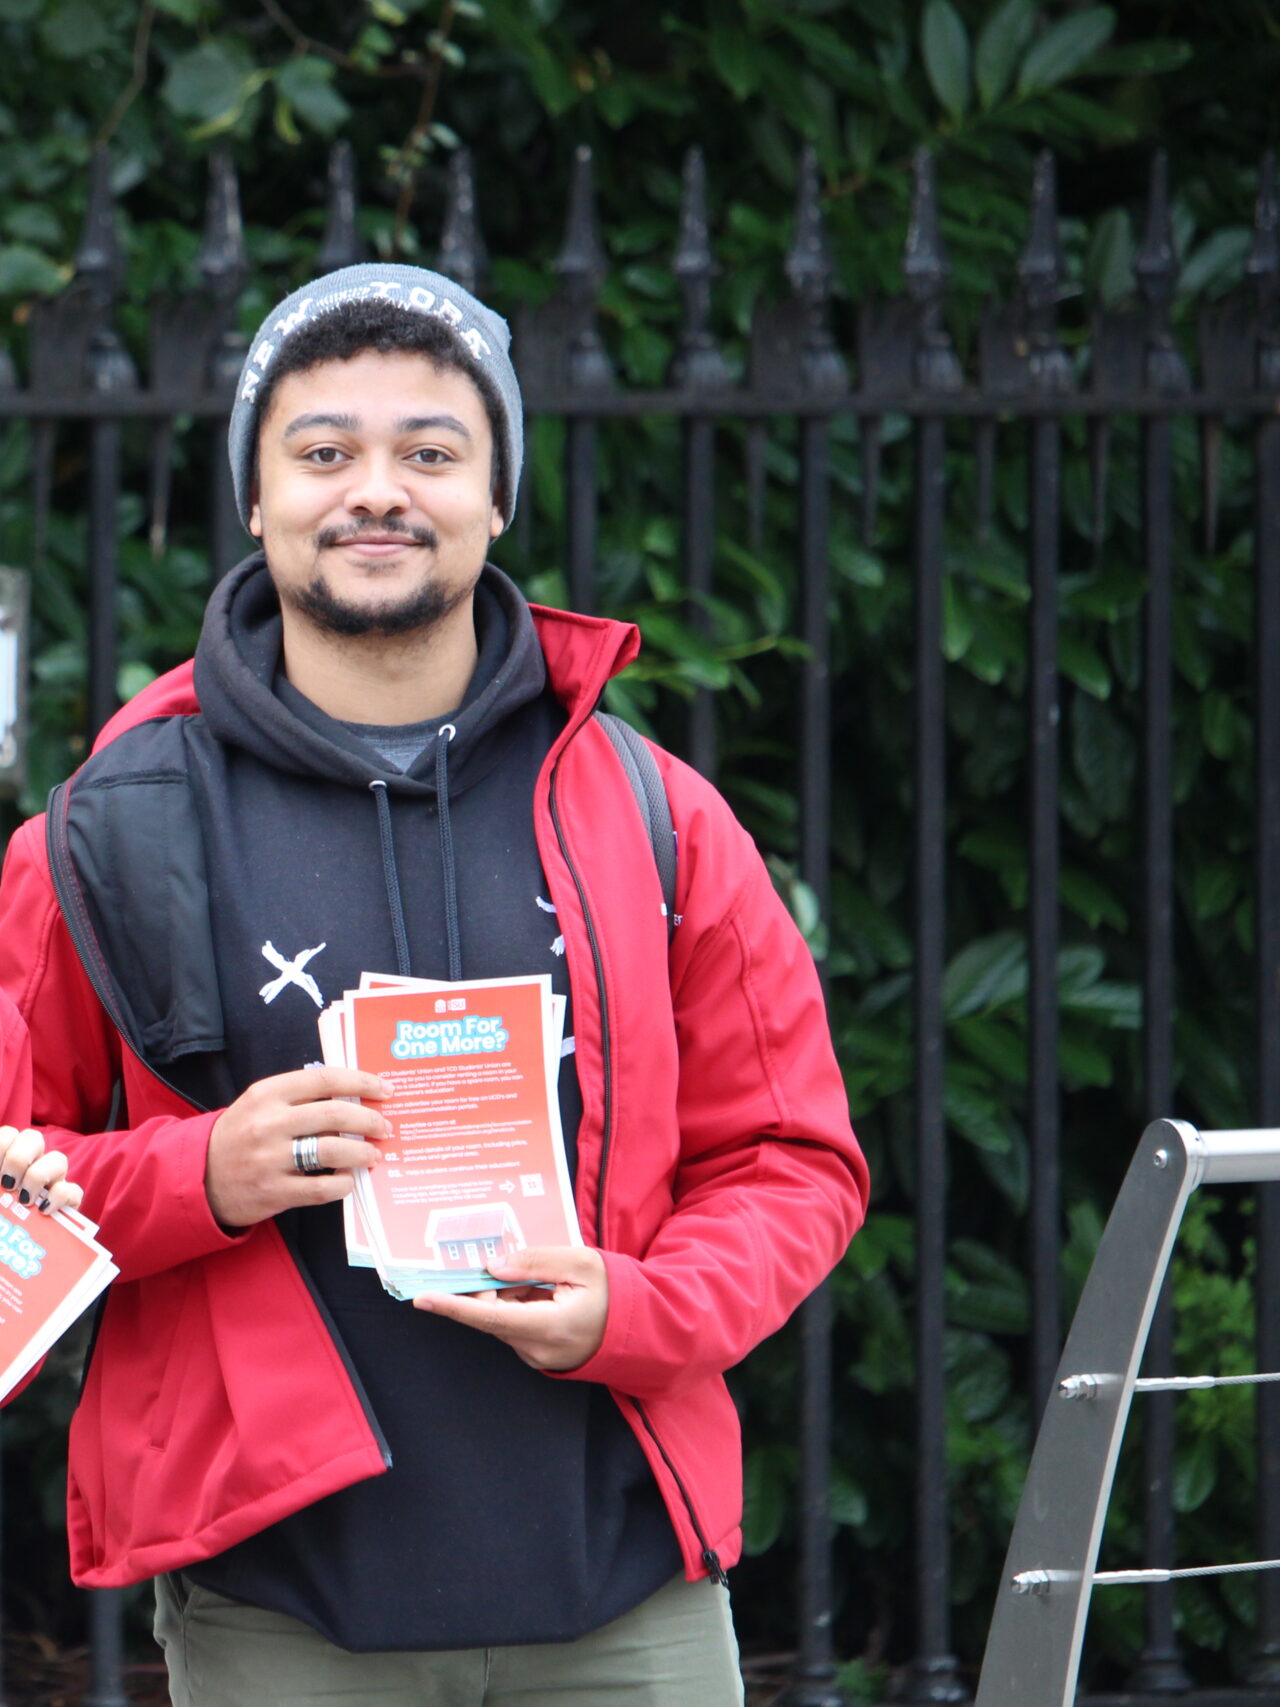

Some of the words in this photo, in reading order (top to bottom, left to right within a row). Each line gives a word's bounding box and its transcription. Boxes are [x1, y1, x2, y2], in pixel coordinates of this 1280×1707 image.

[400, 1021, 462, 1040] Room
[465, 1017, 500, 1034] For
[394, 1038, 437, 1057] One
[441, 1032, 506, 1053] More?
[9, 1228, 43, 1261] For
